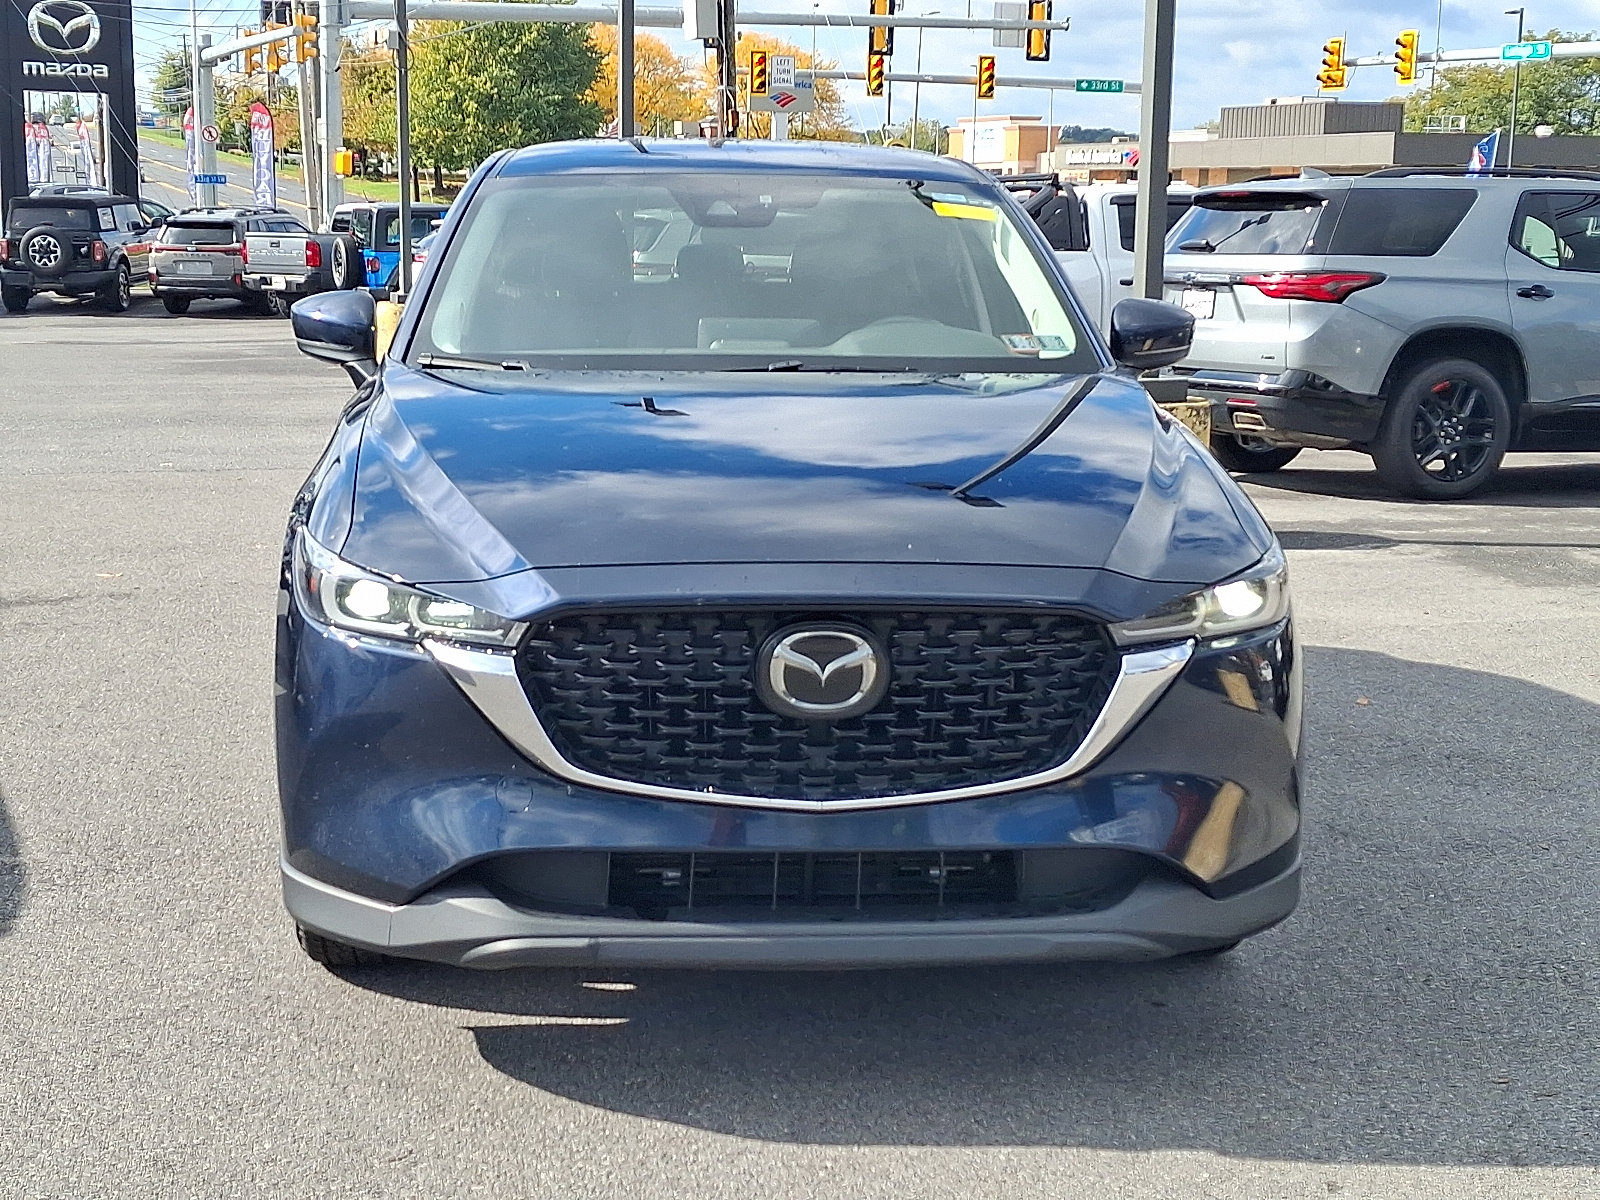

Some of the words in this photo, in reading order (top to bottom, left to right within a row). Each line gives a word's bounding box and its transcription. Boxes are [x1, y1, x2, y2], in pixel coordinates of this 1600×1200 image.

[776, 58, 790, 66] LEFT
[776, 67, 791, 75] TURN
[773, 76, 792, 84] SIGNAL
[795, 80, 812, 89] erica
[1091, 80, 1108, 90] 33rd
[1111, 80, 1120, 90] St
